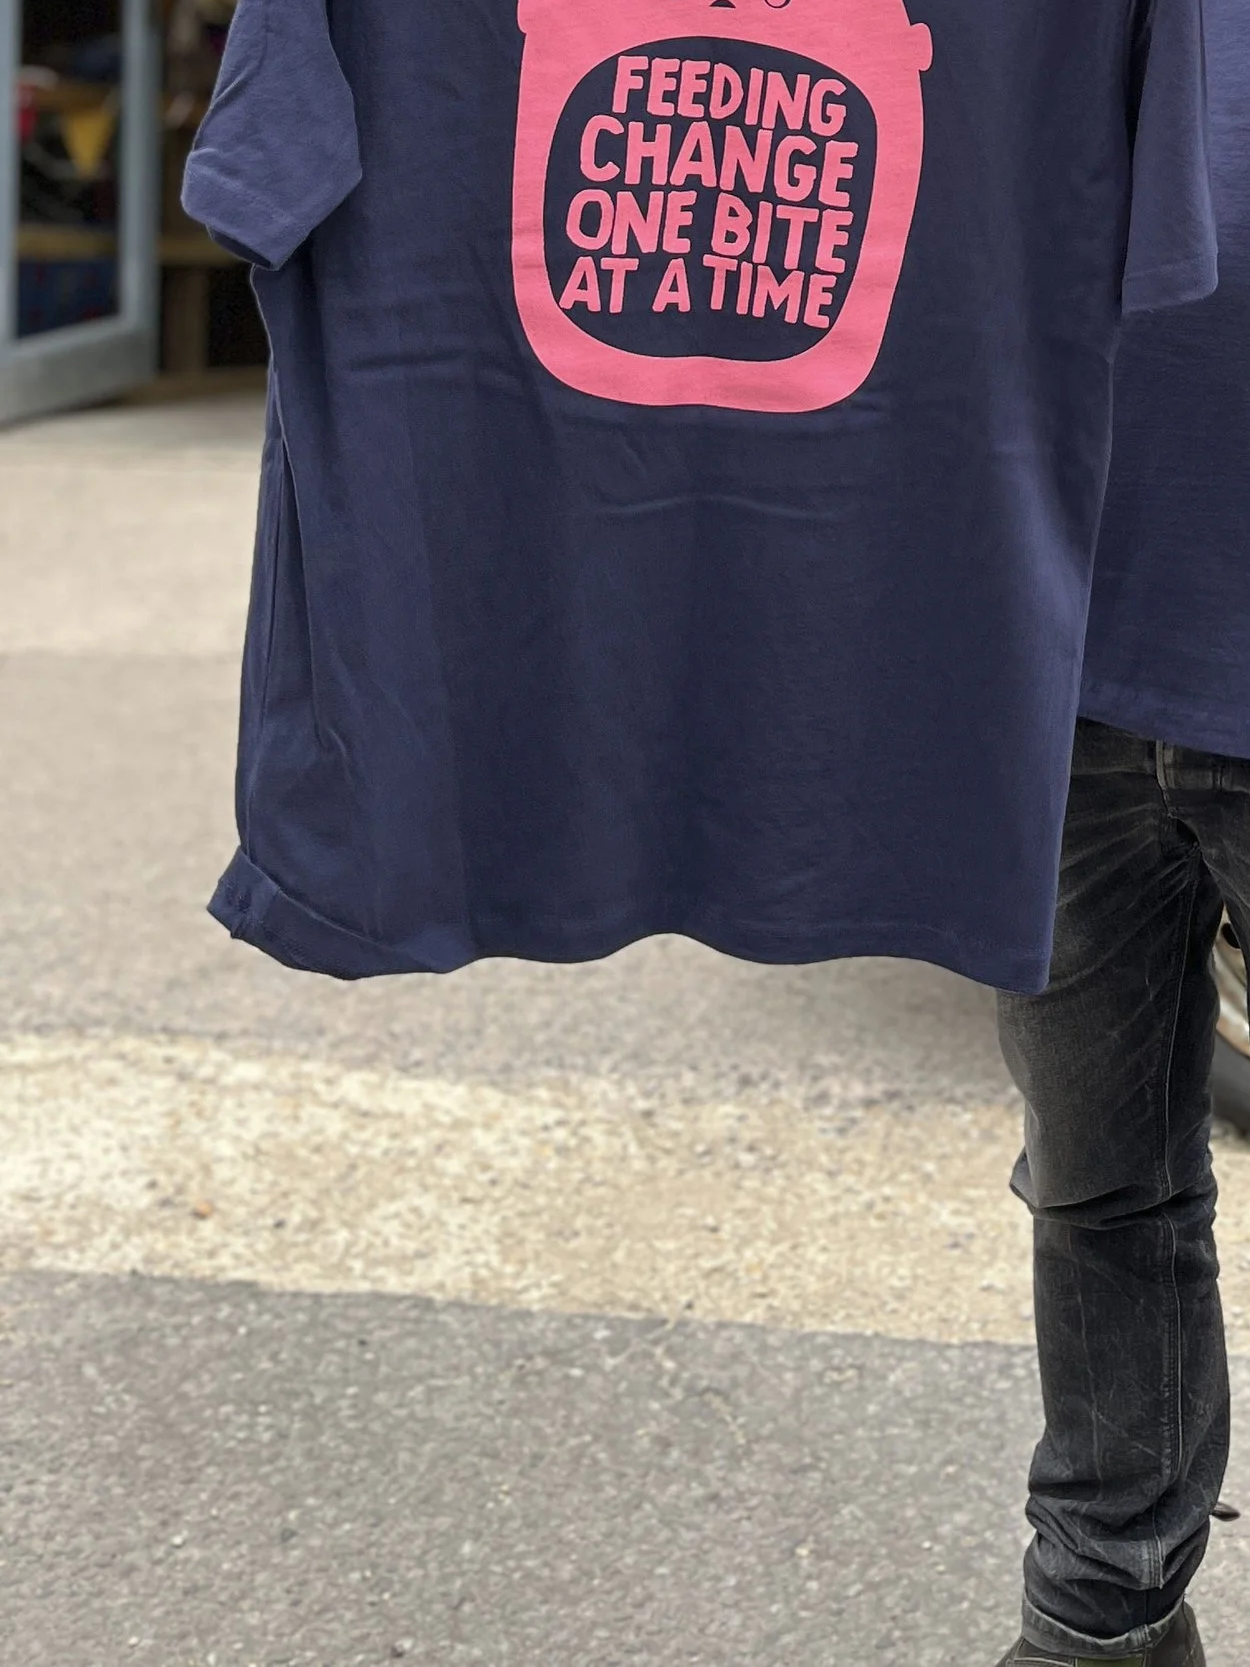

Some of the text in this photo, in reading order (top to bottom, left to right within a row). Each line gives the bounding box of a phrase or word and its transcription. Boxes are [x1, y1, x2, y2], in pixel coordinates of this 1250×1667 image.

[612, 56, 847, 136] FEEDING
[580, 115, 858, 207] CHANGE
[566, 189, 854, 273] ONE BITE
[559, 254, 837, 328] AT A TIME
